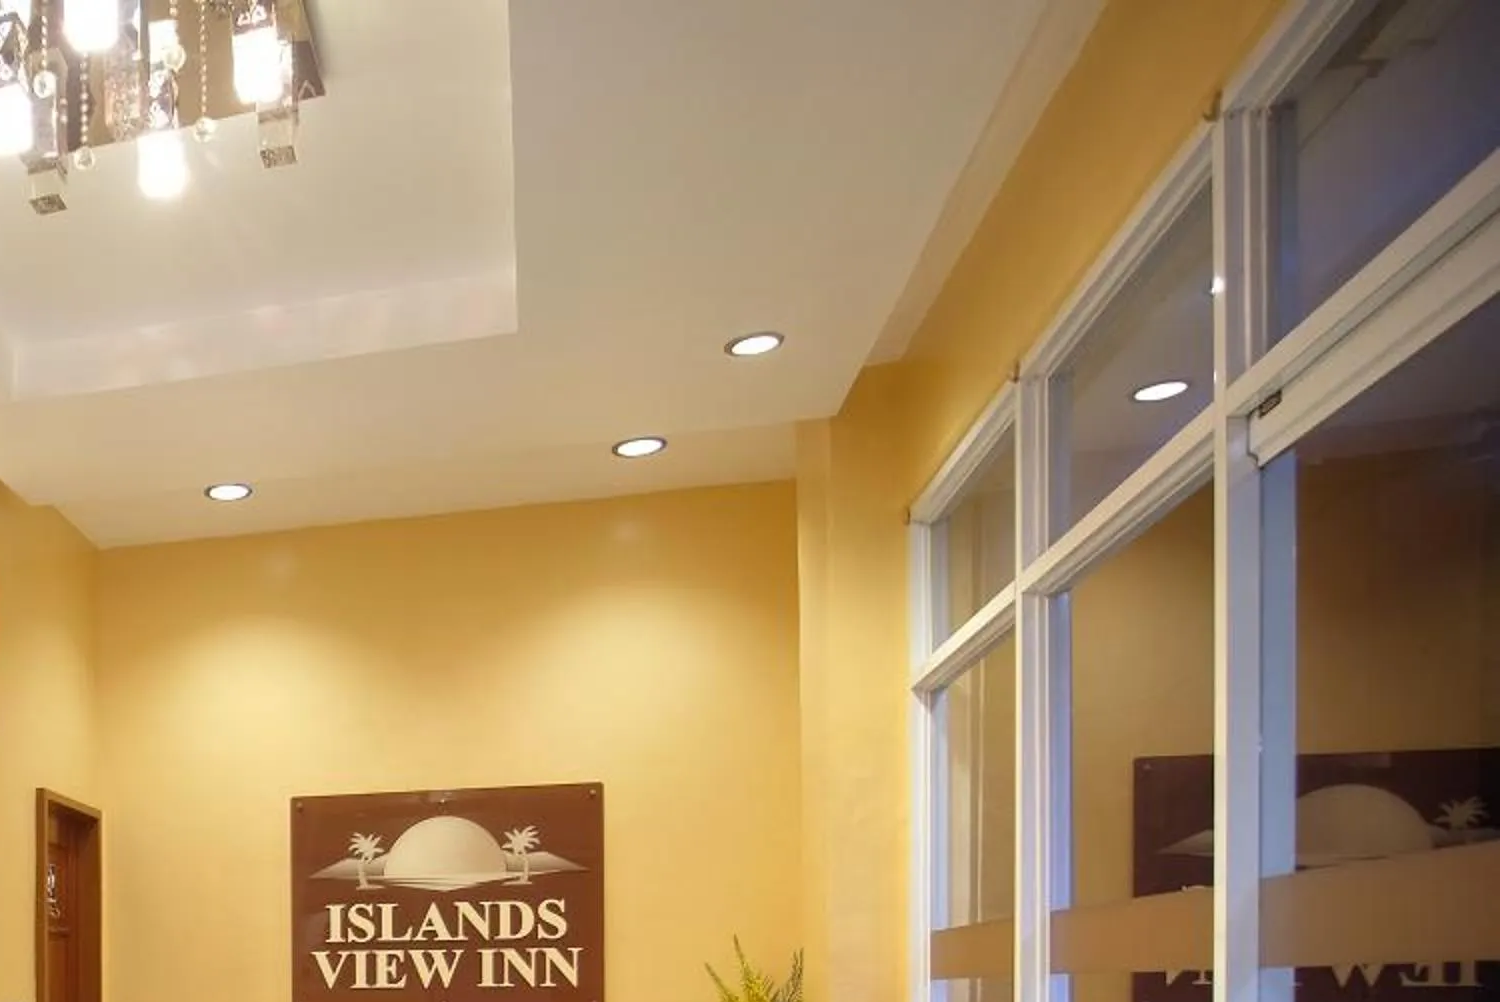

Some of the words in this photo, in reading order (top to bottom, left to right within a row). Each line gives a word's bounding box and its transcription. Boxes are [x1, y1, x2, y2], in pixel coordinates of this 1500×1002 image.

[325, 898, 567, 943] ISLANDS
[311, 949, 465, 989] VIEW
[477, 947, 583, 988] INN
